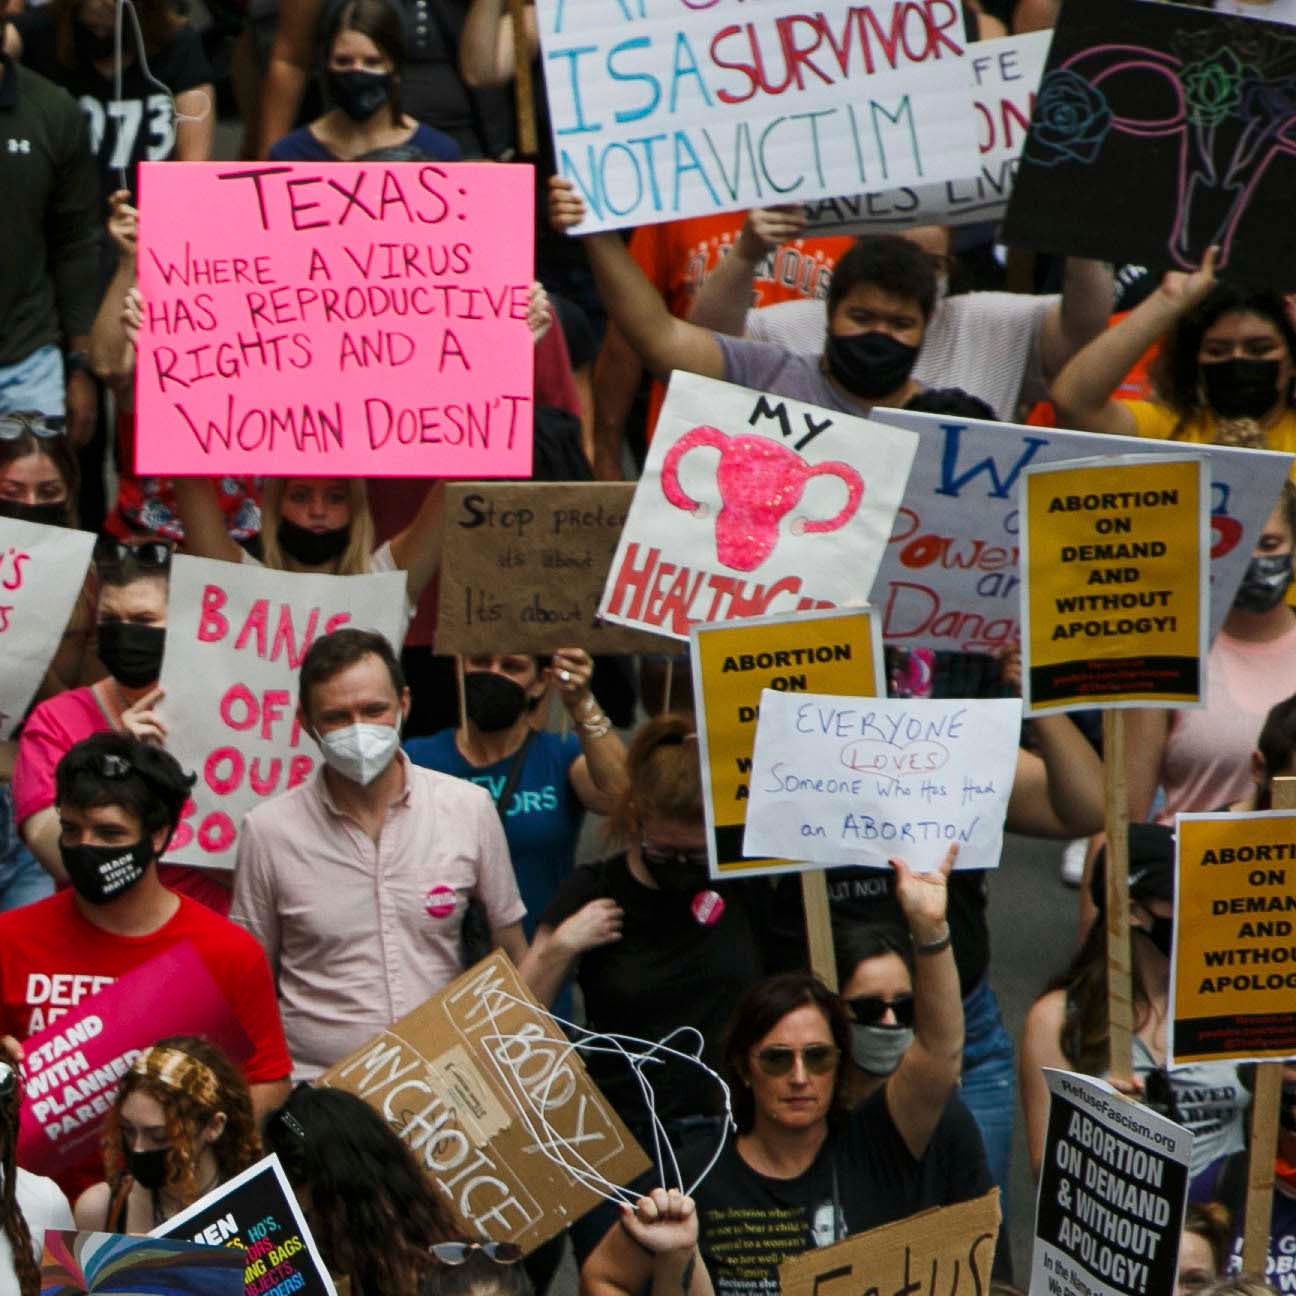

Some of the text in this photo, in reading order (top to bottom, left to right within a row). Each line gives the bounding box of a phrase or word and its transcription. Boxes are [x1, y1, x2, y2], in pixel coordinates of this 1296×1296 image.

[218, 167, 468, 231] TEXAS:
[148, 242, 472, 286] WHERE A VIRUS
[147, 284, 530, 335] HAS REPRODUCTIVE
[154, 330, 469, 394] RIGHTS AND A
[749, 395, 833, 450] MY
[1049, 489, 1178, 513] ABORTION
[1095, 517, 1132, 535] ON
[1061, 541, 1167, 562] DEMAND
[1087, 567, 1140, 585] AND
[1055, 591, 1172, 614] WITHOUT
[1051, 616, 1177, 641] APOLOGY!
[722, 643, 851, 674] ABORTION
[848, 750, 938, 770] LOVES
[1248, 870, 1285, 886] ON
[1238, 921, 1292, 938] AND
[1066, 1109, 1166, 1188] ABORTION
